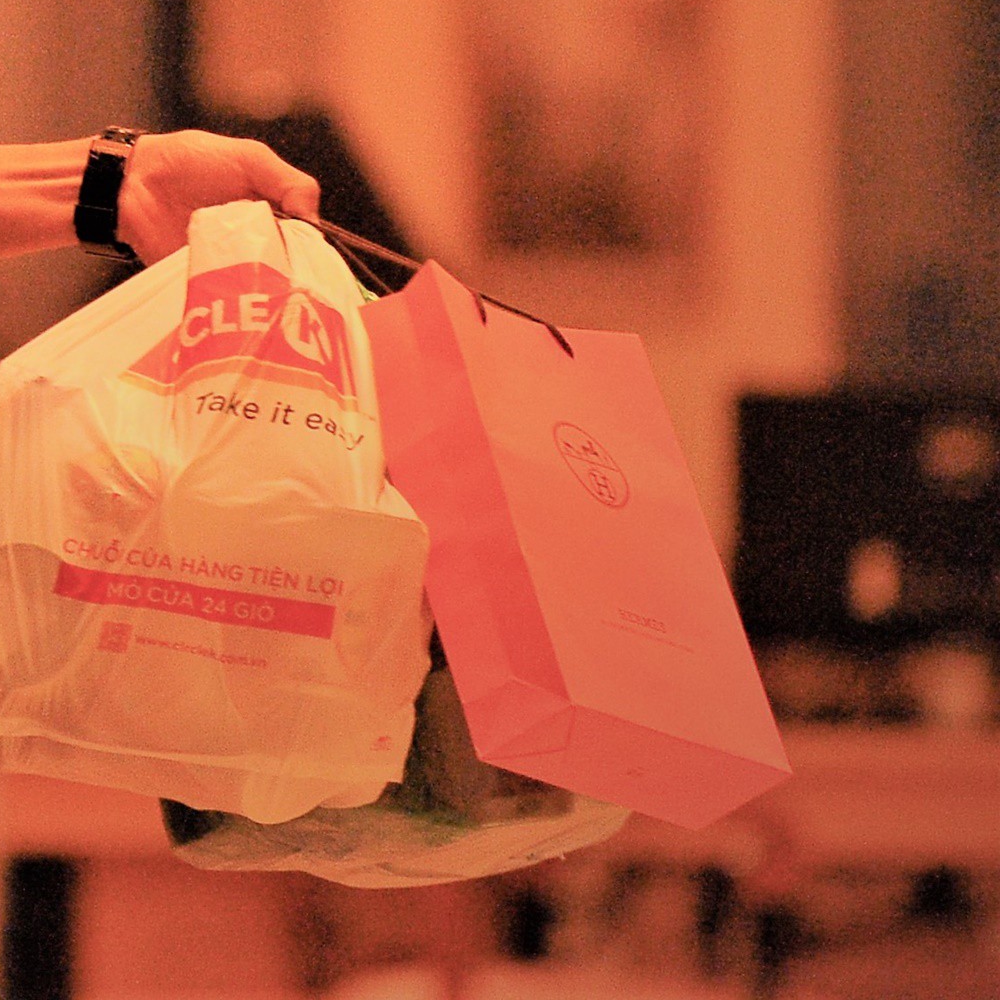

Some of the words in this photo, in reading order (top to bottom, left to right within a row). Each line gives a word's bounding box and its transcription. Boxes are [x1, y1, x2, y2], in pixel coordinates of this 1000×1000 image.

[172, 293, 271, 364] CLE
[196, 391, 260, 420] Take
[271, 401, 295, 425] it
[62, 538, 120, 563] CHUỖ
[179, 555, 244, 582] HÀNG
[248, 566, 300, 591] TIỆN
[201, 596, 227, 614] 24
